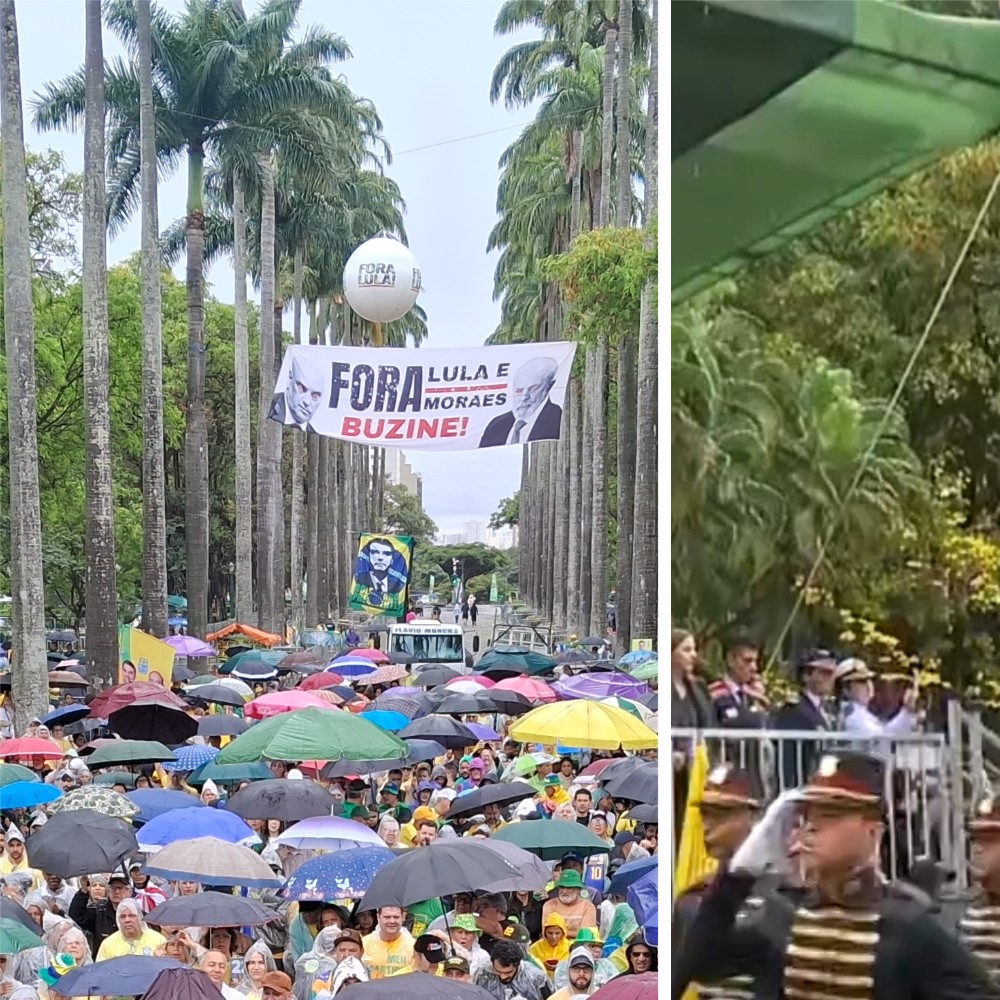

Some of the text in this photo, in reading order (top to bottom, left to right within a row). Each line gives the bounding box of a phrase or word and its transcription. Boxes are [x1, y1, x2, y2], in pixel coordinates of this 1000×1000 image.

[359, 263, 396, 275] FORA
[358, 274, 396, 285] LULA!
[428, 363, 510, 382] LULA E
[328, 361, 423, 412] FORA
[424, 393, 507, 410] MORAES
[341, 416, 469, 439] BUZINE!
[591, 867, 602, 879] 10
